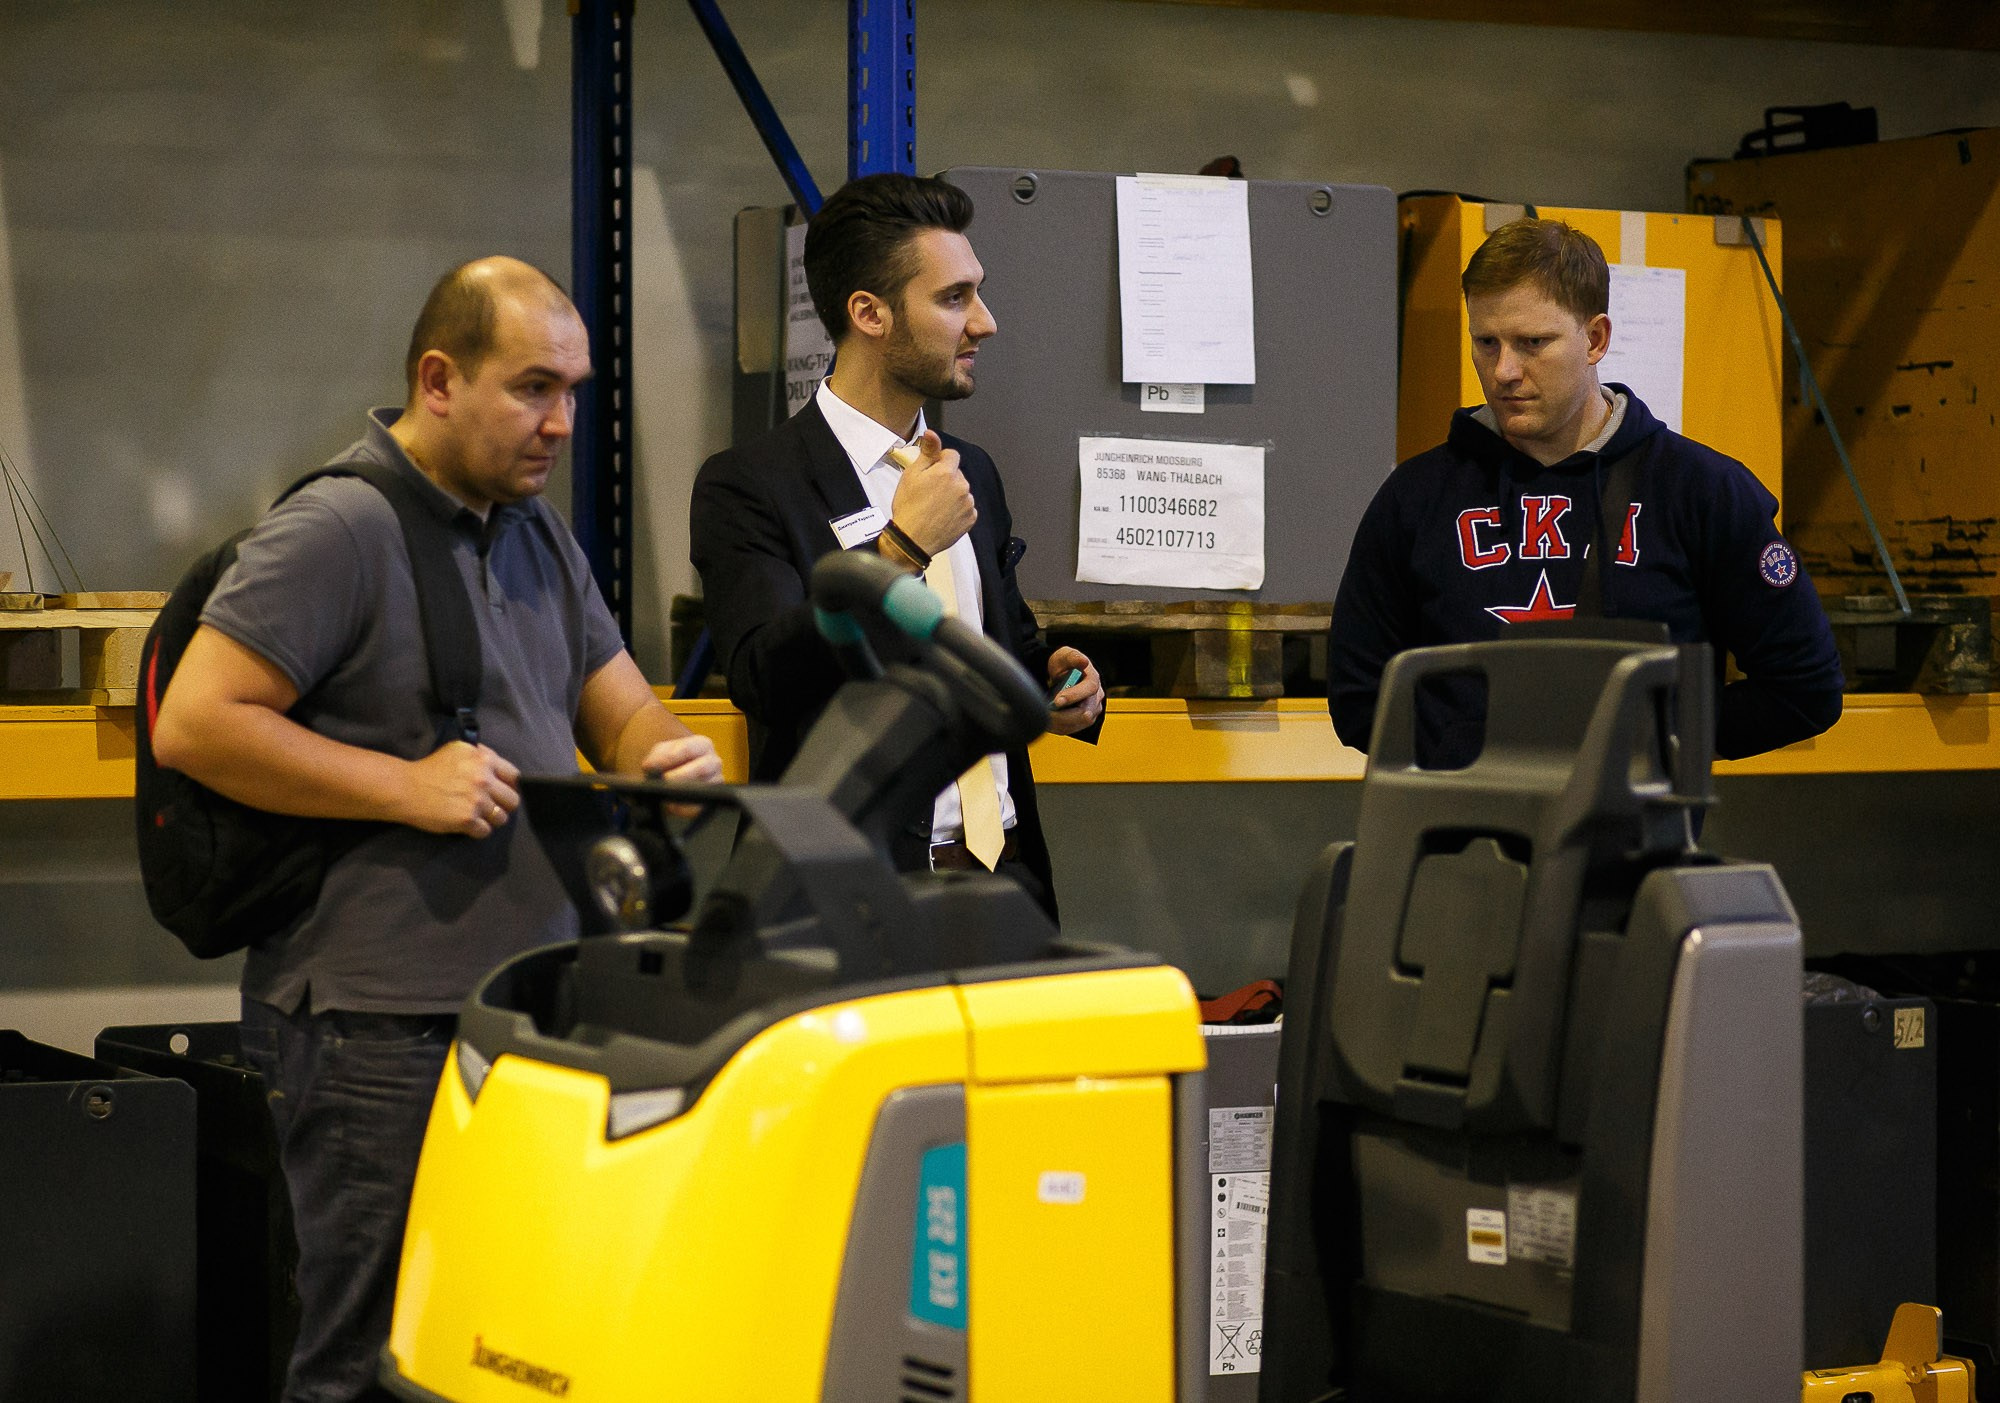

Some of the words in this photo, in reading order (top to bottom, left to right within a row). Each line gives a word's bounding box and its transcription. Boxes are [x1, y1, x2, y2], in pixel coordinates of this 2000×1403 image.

[1148, 385, 1169, 401] Pb
[1094, 452, 1154, 464] JUNGHEINRICH
[1156, 455, 1203, 467] MOOSBURG
[1096, 467, 1126, 480] 85368
[1120, 495, 1218, 517] 1100346682
[1116, 527, 1215, 549] 4502107713
[1222, 1362, 1236, 1372] Pb
